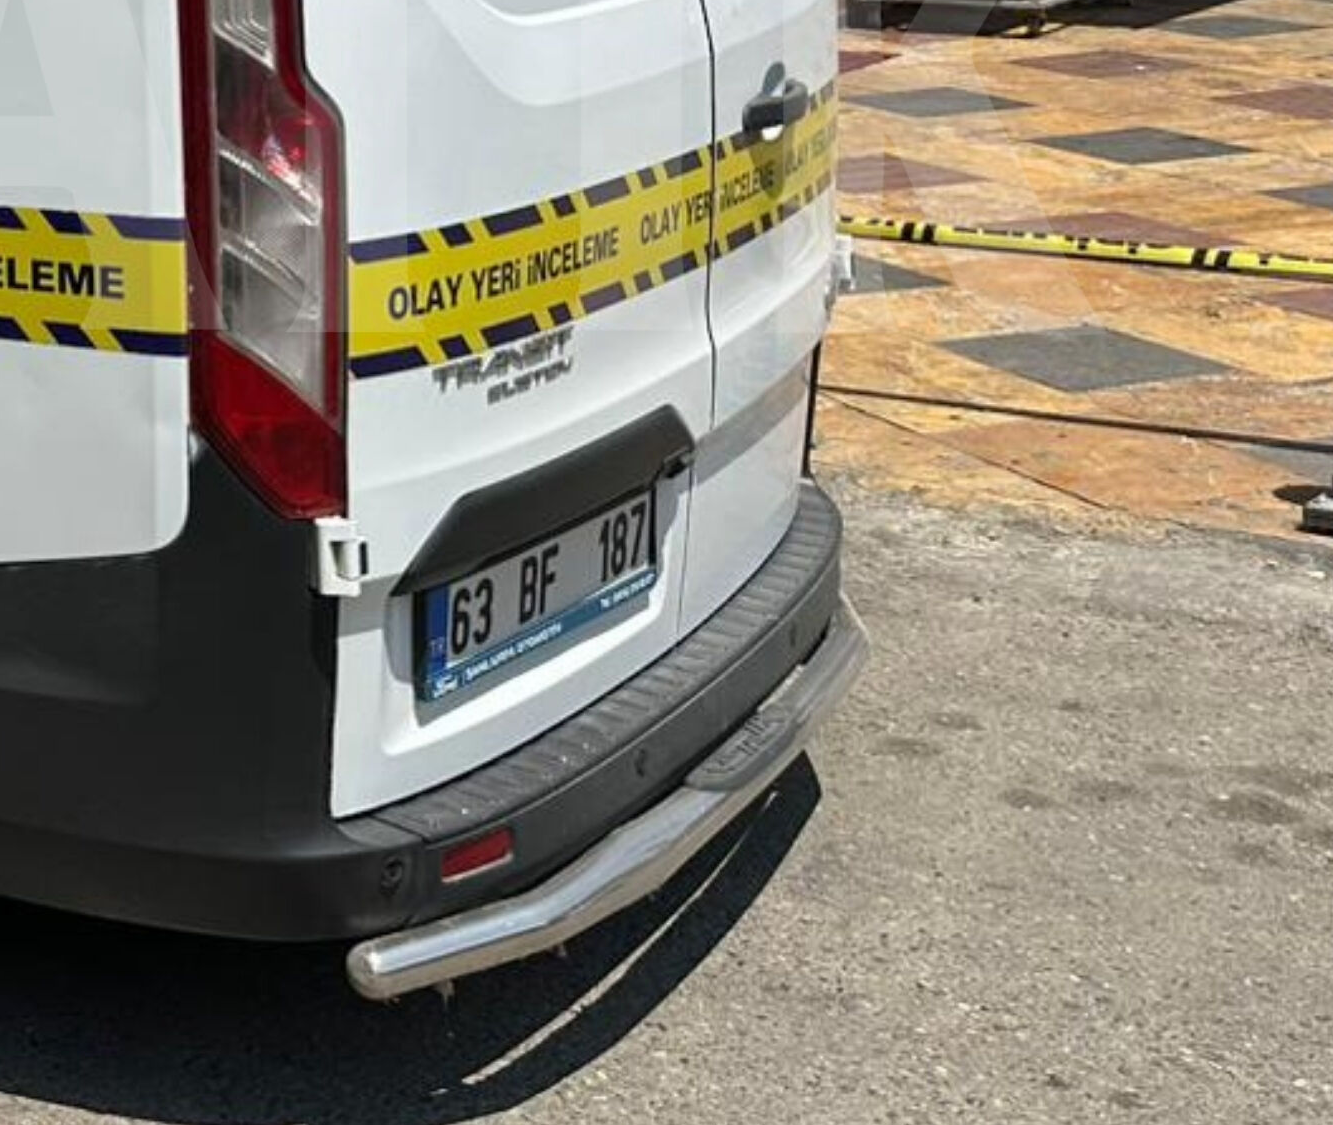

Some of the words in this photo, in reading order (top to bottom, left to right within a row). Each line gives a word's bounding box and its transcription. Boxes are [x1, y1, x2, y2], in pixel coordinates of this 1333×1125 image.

[641, 200, 681, 245] OLAY
[389, 270, 464, 321] OLAY
[451, 578, 494, 655] 63
[519, 542, 560, 625] BF
[598, 500, 648, 583] 187
